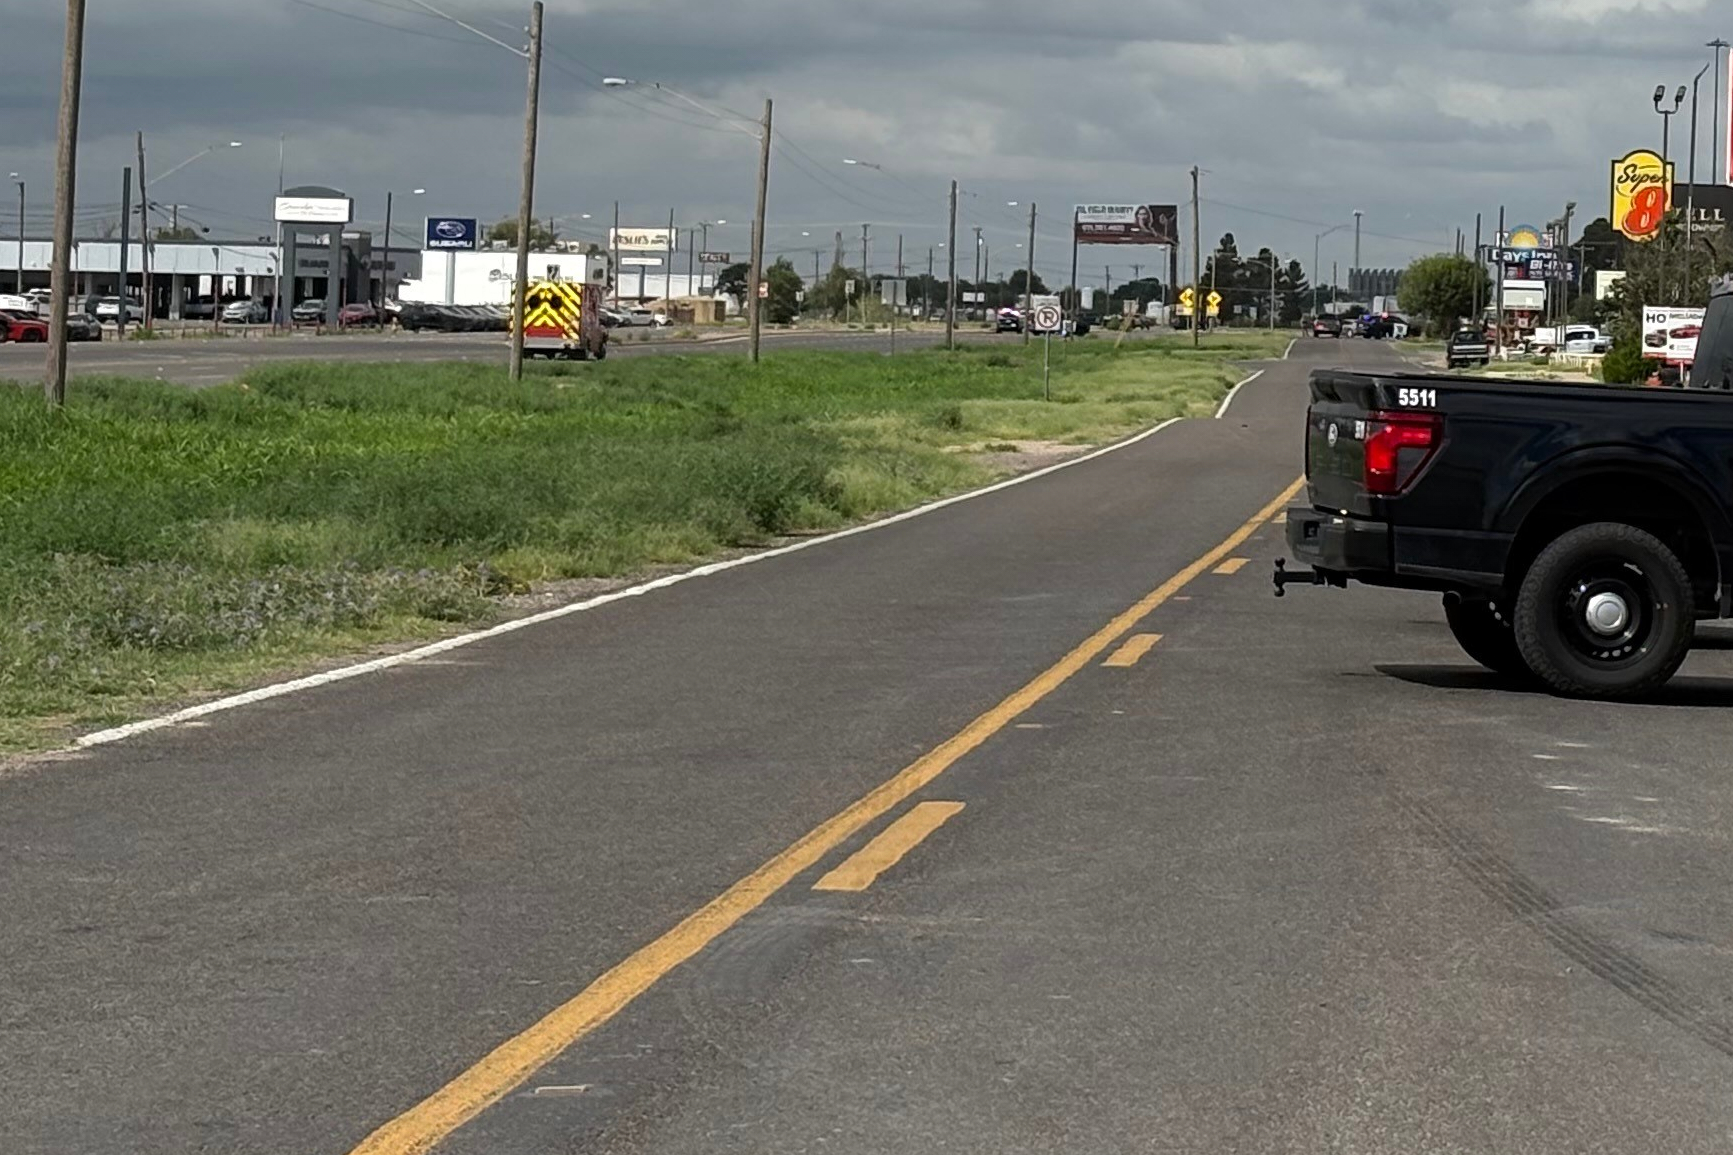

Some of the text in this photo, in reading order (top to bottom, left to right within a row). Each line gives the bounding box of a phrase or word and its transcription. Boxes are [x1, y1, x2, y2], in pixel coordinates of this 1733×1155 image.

[1616, 163, 1669, 194] Super
[1622, 186, 1669, 235] 8
[429, 240, 473, 248] SUBARU
[1492, 249, 1530, 263] Days
[1398, 388, 1437, 407] 5511
